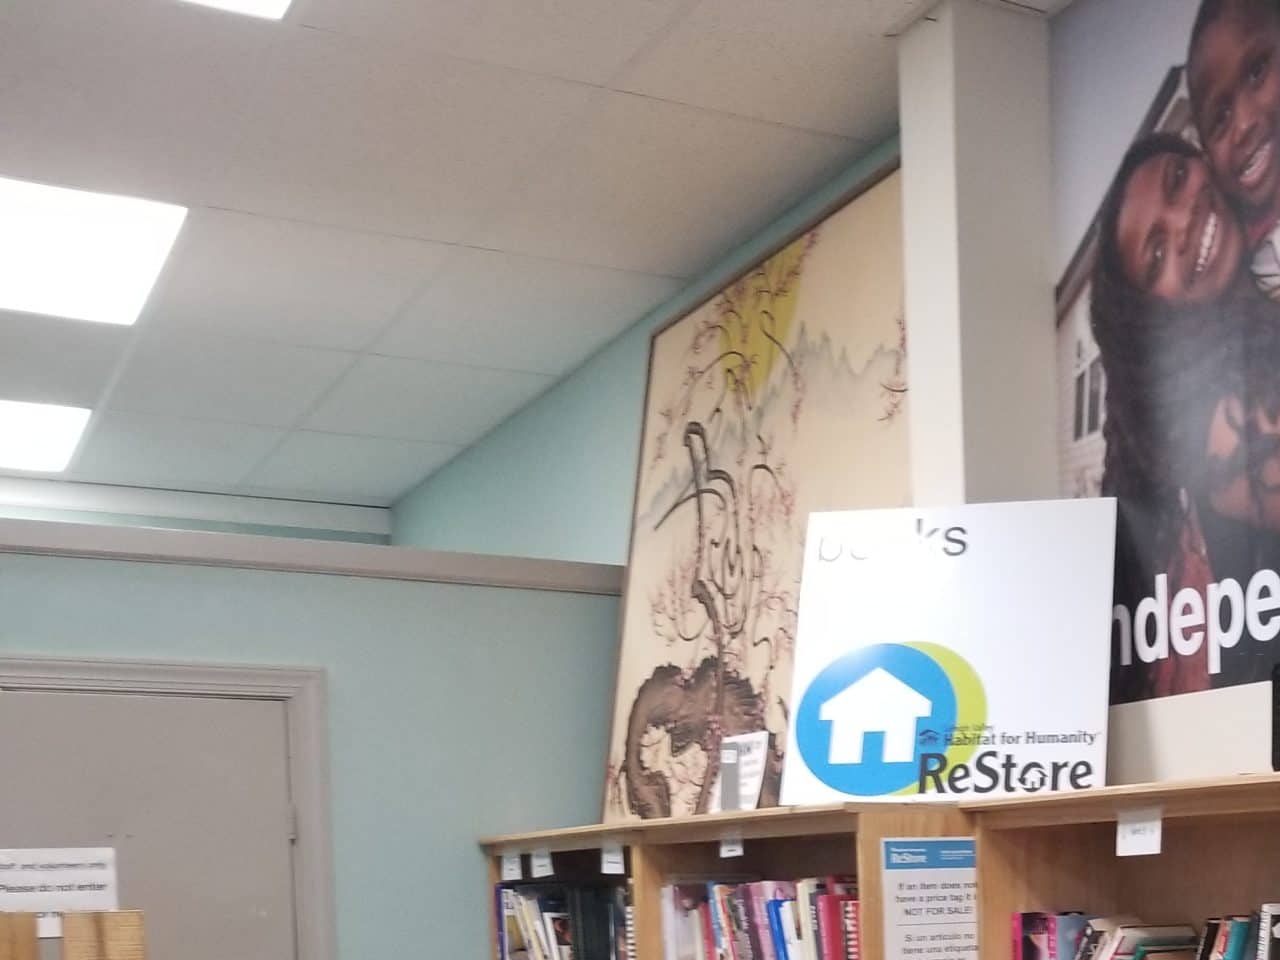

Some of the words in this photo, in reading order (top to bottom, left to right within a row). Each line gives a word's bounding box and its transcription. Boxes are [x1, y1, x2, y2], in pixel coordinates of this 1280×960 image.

[944, 730, 996, 746] Habitat
[1001, 731, 1021, 745] for
[1025, 730, 1097, 746] Humanity
[917, 750, 1094, 794] ReStore
[904, 907, 923, 916] NOT
[926, 907, 945, 916] FOR
